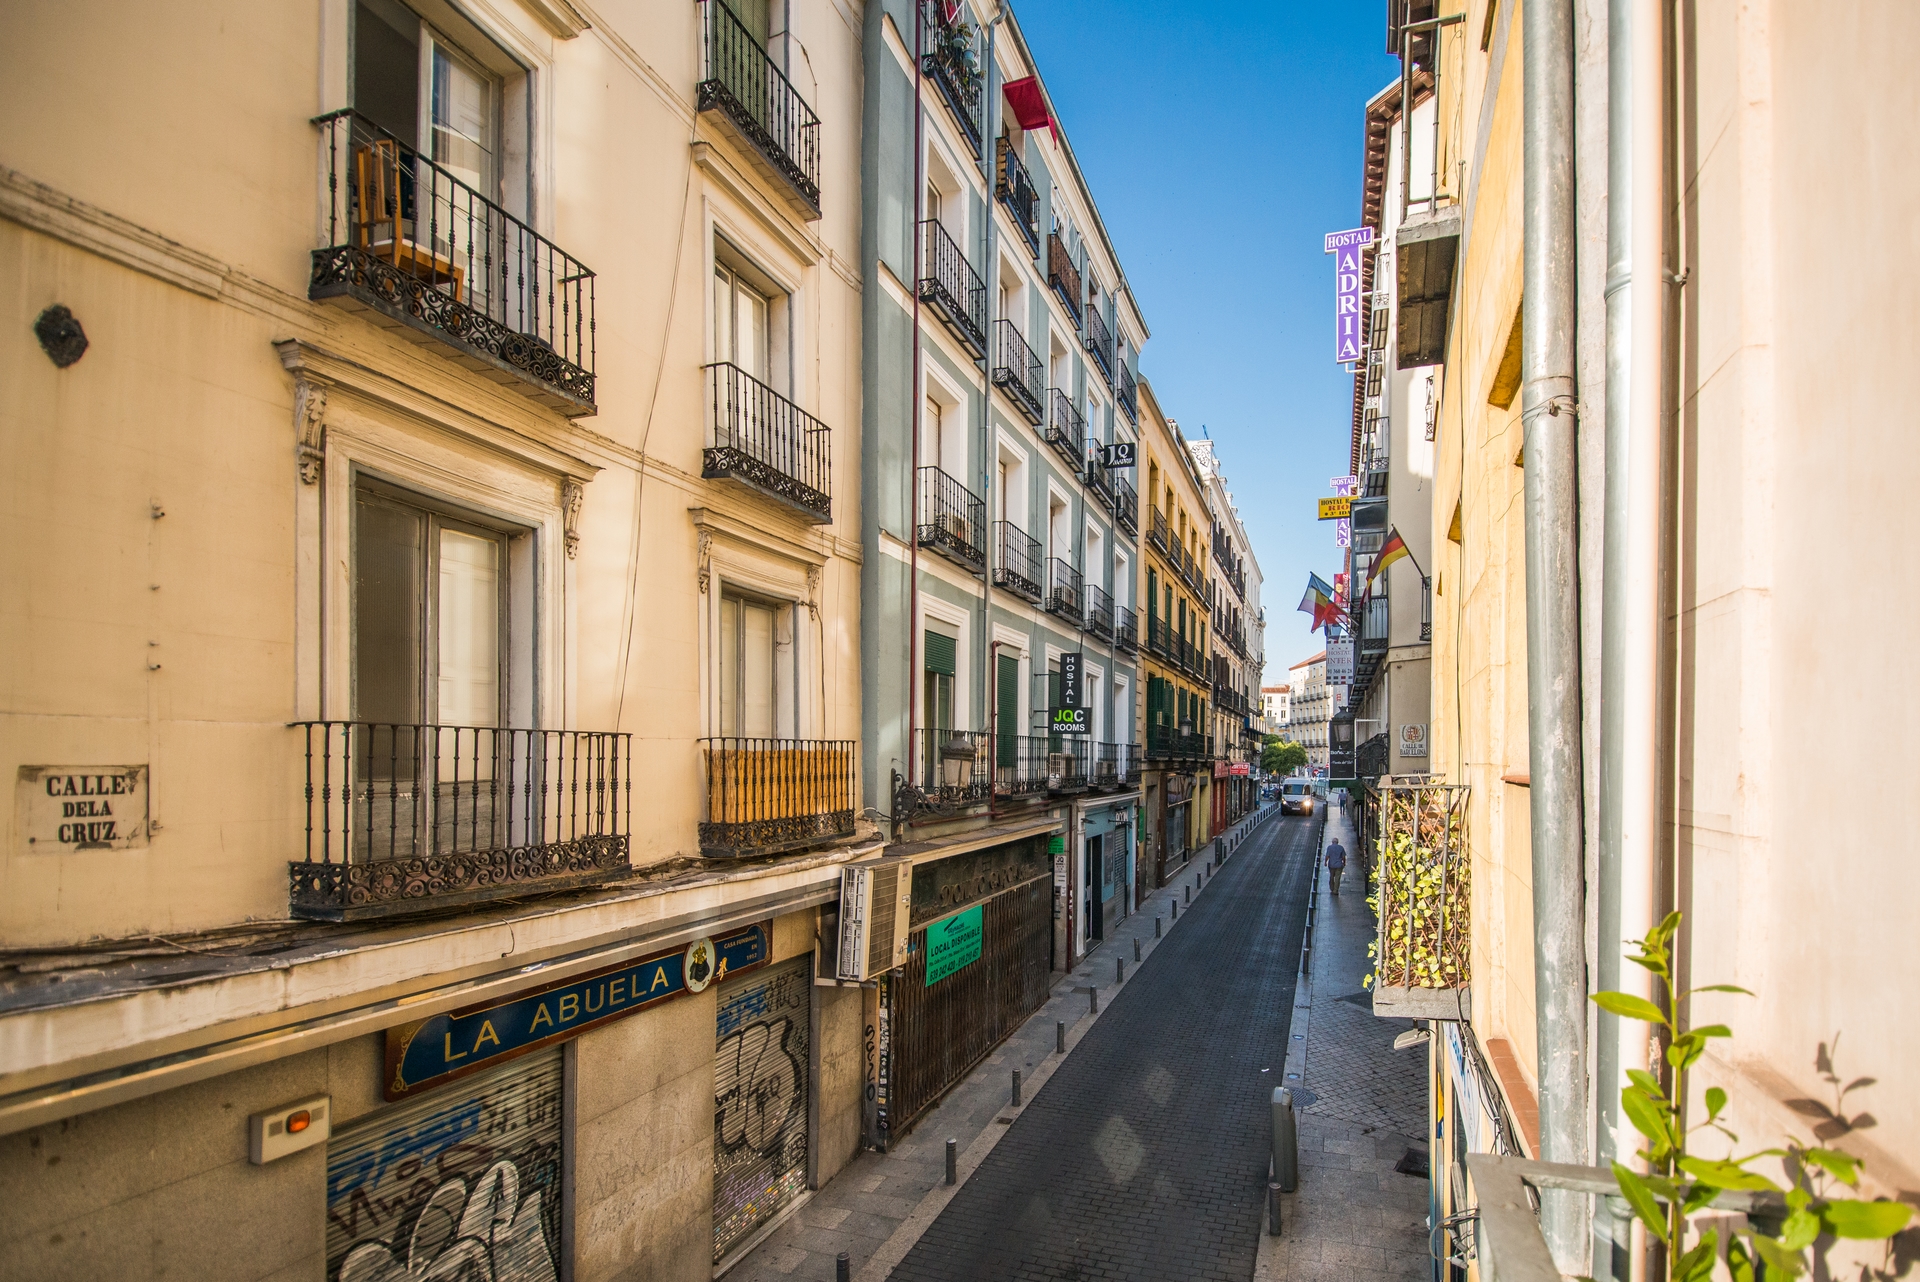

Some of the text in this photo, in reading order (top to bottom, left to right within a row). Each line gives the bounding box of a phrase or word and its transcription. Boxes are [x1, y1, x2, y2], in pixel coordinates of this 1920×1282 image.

[1328, 231, 1370, 248] HOSTAL
[1339, 252, 1358, 357] ADRIA
[1066, 656, 1075, 704] HOSTAL
[1054, 709, 1084, 722] JQC
[1053, 723, 1085, 731] ROOMS
[46, 775, 126, 796] CALLE
[58, 821, 117, 843] CRUZ
[724, 935, 757, 949] CASA FUNDADA
[930, 941, 950, 957] LOCAL
[951, 926, 981, 948] DISPONIBLE
[444, 966, 669, 1062] LA ABUELA
